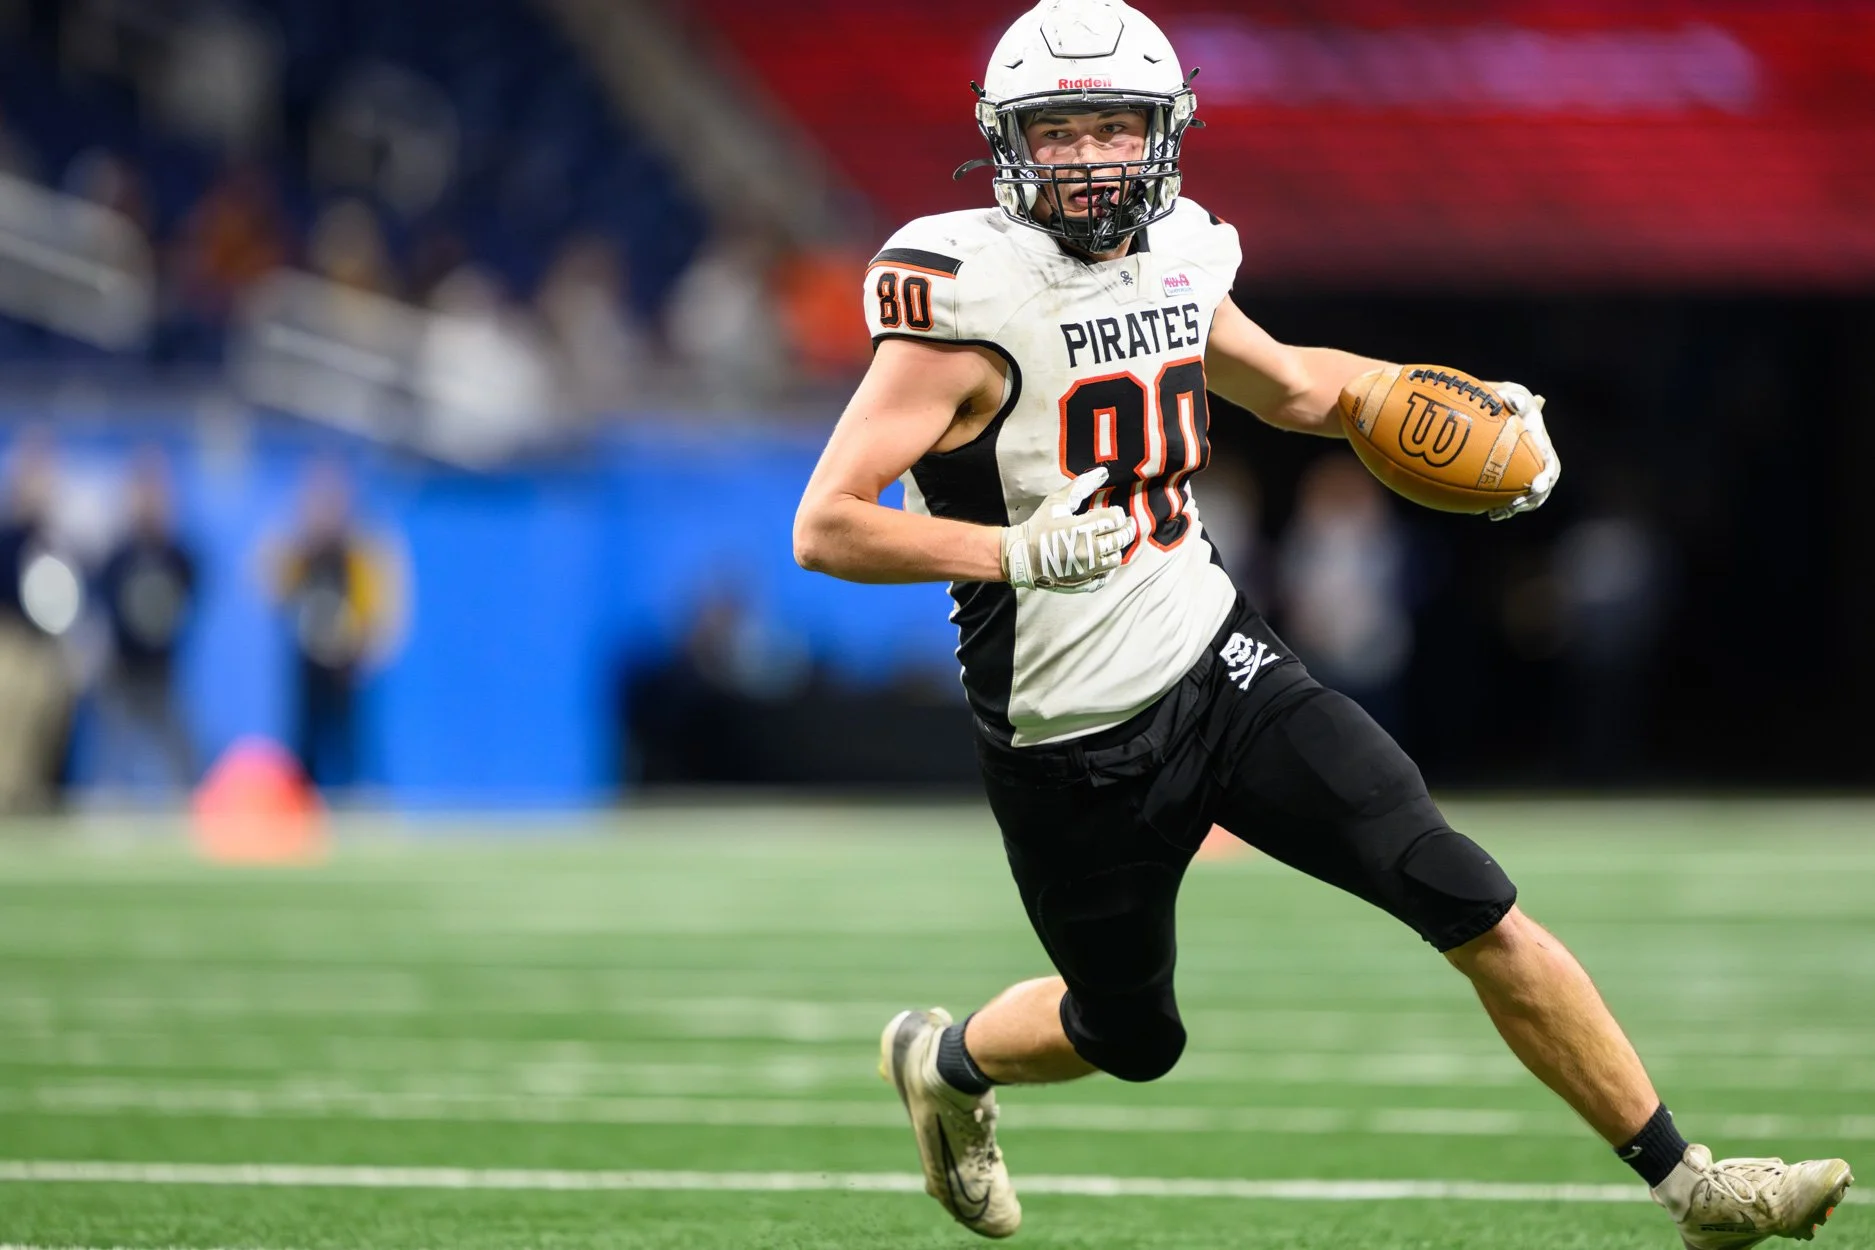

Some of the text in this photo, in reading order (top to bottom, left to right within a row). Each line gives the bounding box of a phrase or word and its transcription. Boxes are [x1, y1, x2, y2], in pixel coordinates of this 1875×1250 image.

[876, 271, 934, 331] 80
[1060, 303, 1200, 368] PIRATES
[1058, 355, 1211, 565] 80
